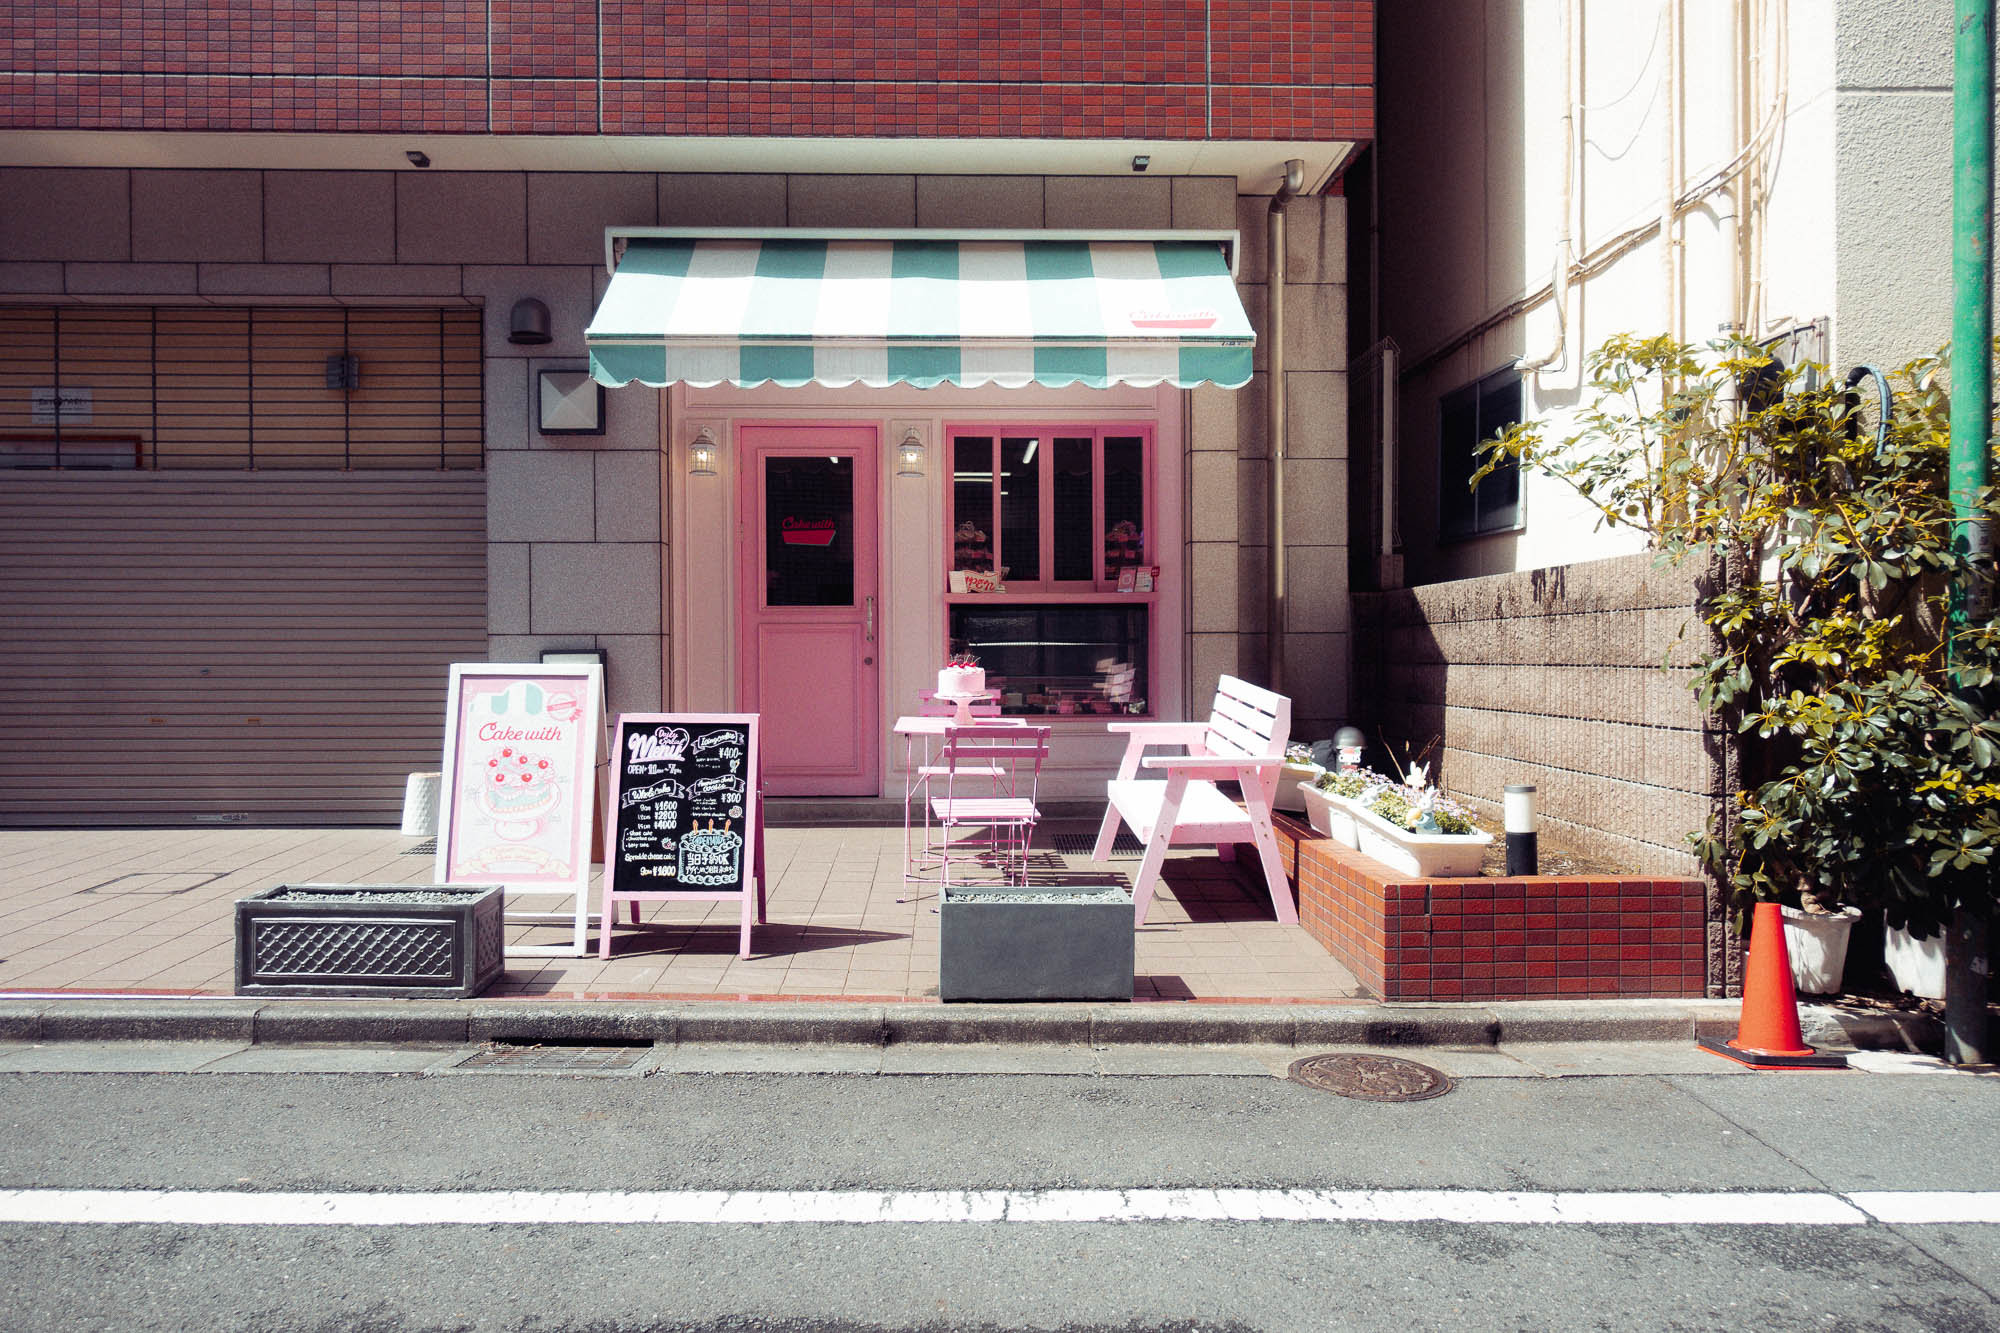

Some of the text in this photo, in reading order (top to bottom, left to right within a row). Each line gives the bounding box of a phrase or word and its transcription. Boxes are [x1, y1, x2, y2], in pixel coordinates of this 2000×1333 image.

[782, 515, 835, 529] Cake with
[478, 721, 562, 741] Cake with
[628, 732, 685, 761] Menu
[627, 764, 645, 775] OPEN
[721, 792, 742, 804] ¥300
[654, 800, 678, 811] ¥1600
[654, 811, 678, 820] ¥2800
[653, 820, 677, 830] ¥4000
[653, 865, 677, 877] ¥1600
